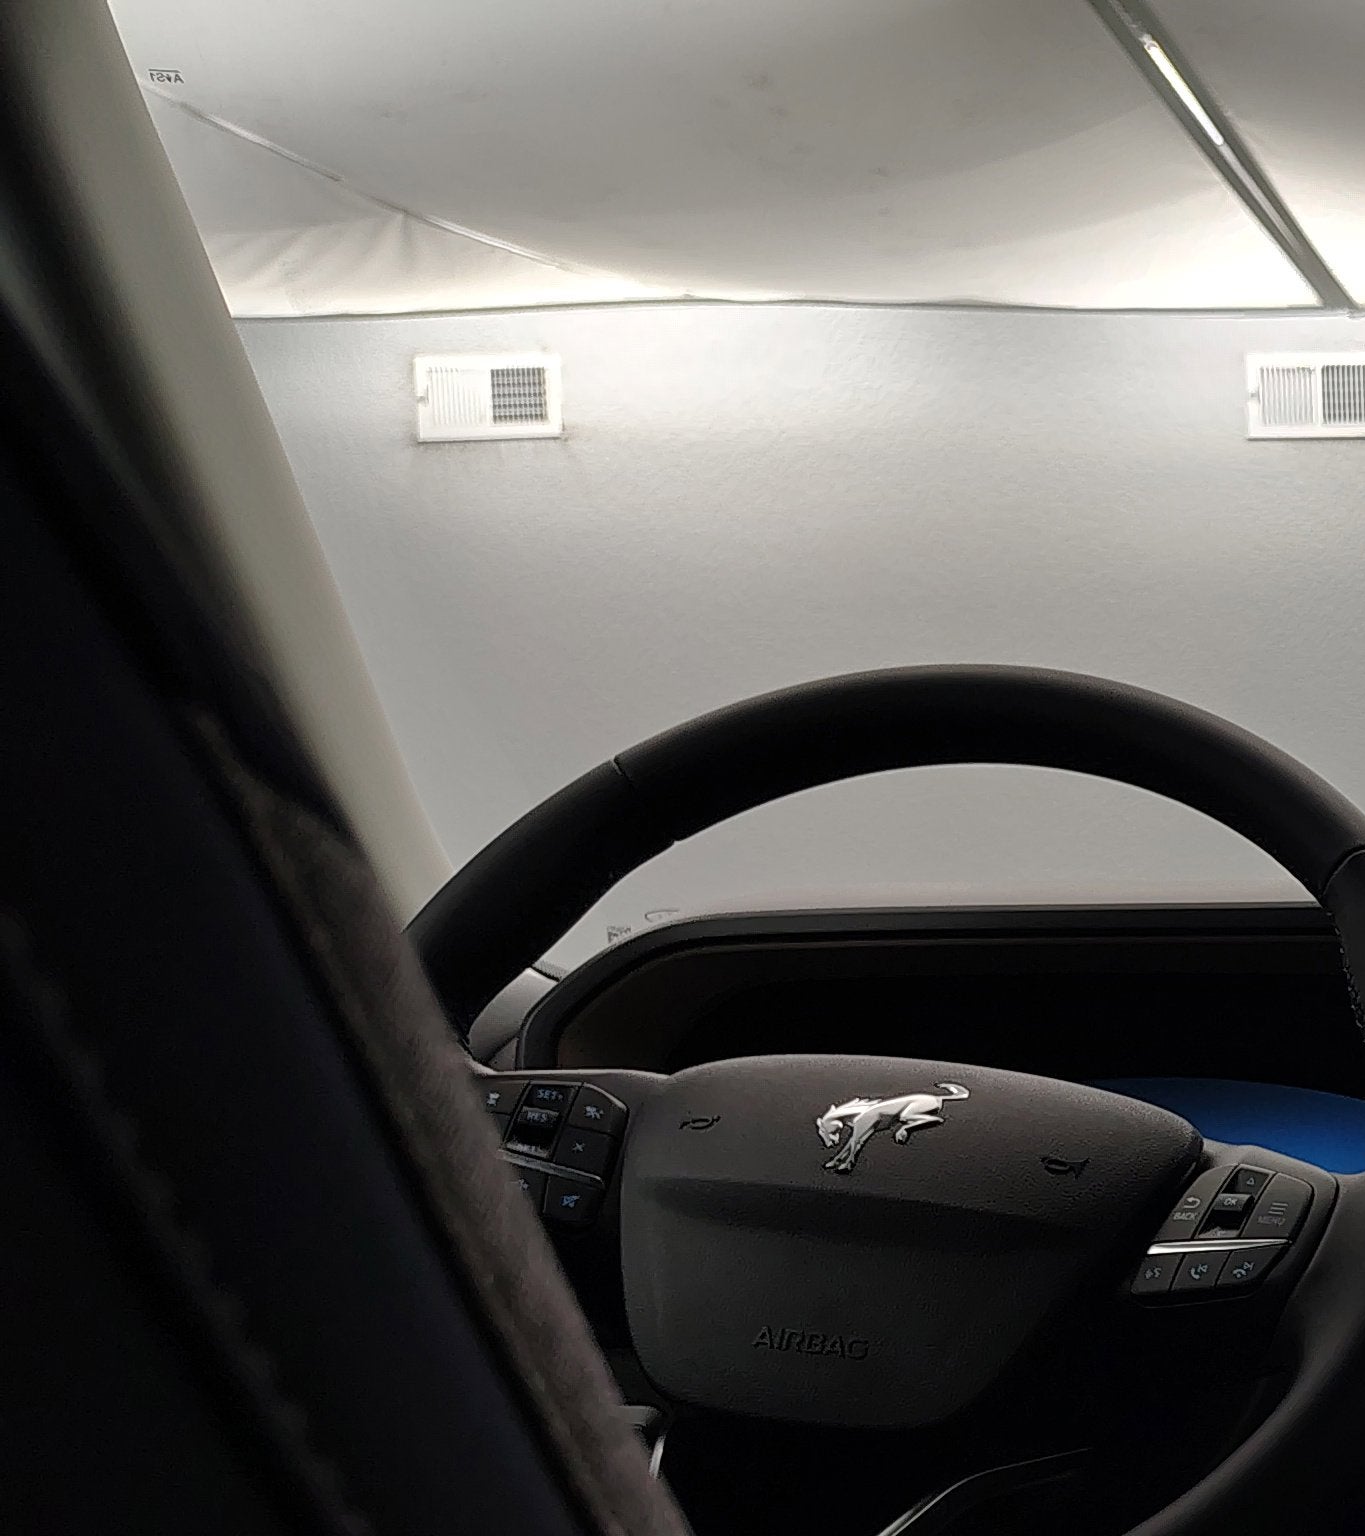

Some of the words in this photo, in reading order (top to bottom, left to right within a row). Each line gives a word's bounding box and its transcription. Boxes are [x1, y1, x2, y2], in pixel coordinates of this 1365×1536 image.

[1224, 1197, 1237, 1206] OK
[1173, 1212, 1198, 1221] BACK
[1257, 1216, 1286, 1226] MENU
[752, 1325, 869, 1360] AIRBAG
